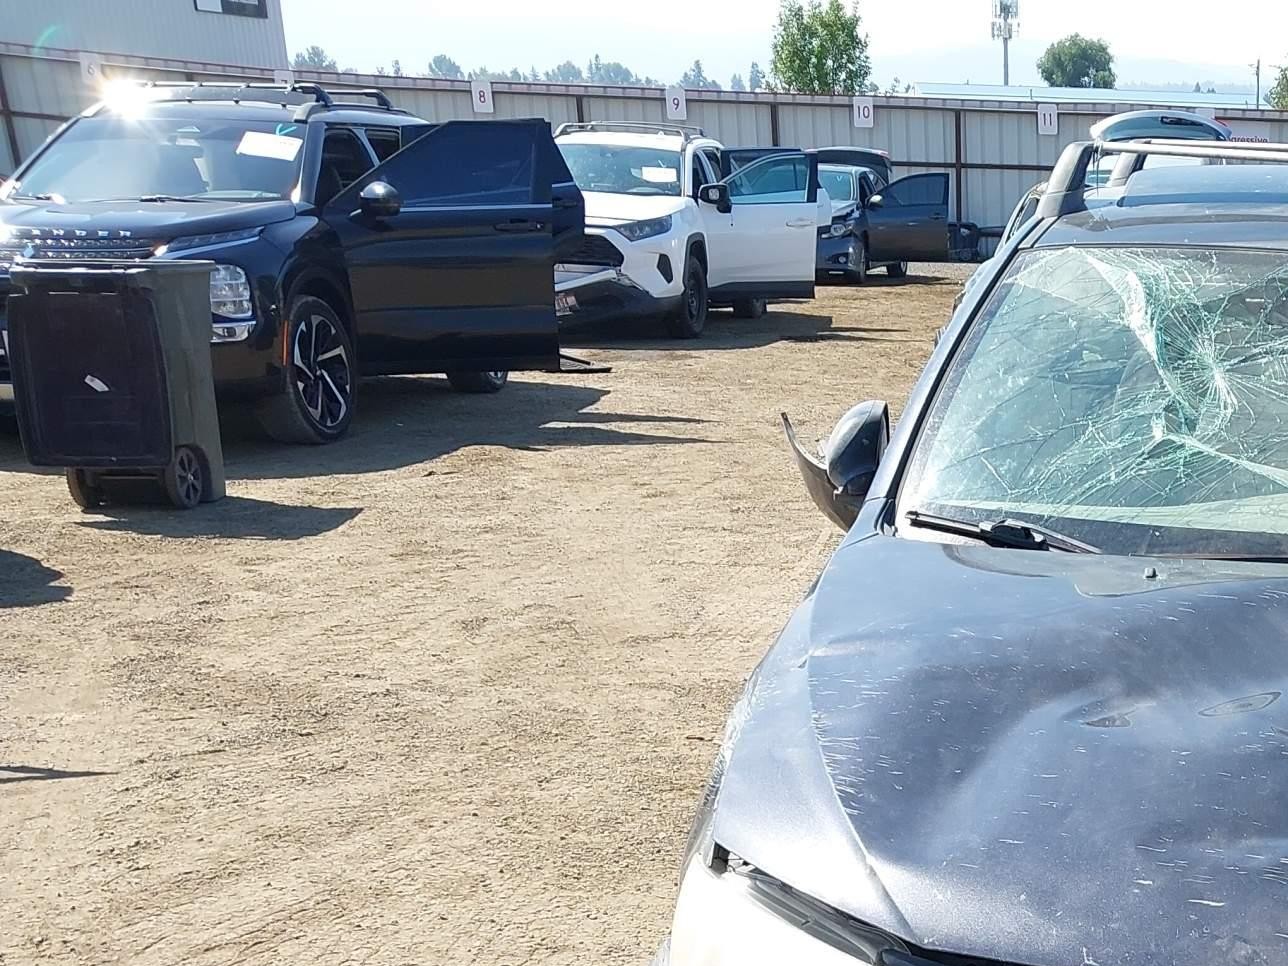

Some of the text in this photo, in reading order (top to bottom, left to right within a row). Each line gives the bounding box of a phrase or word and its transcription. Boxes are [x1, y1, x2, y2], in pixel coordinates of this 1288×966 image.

[479, 90, 486, 104] 8
[672, 97, 680, 111] 9
[857, 105, 870, 119] 10
[1043, 112, 1052, 127] 11
